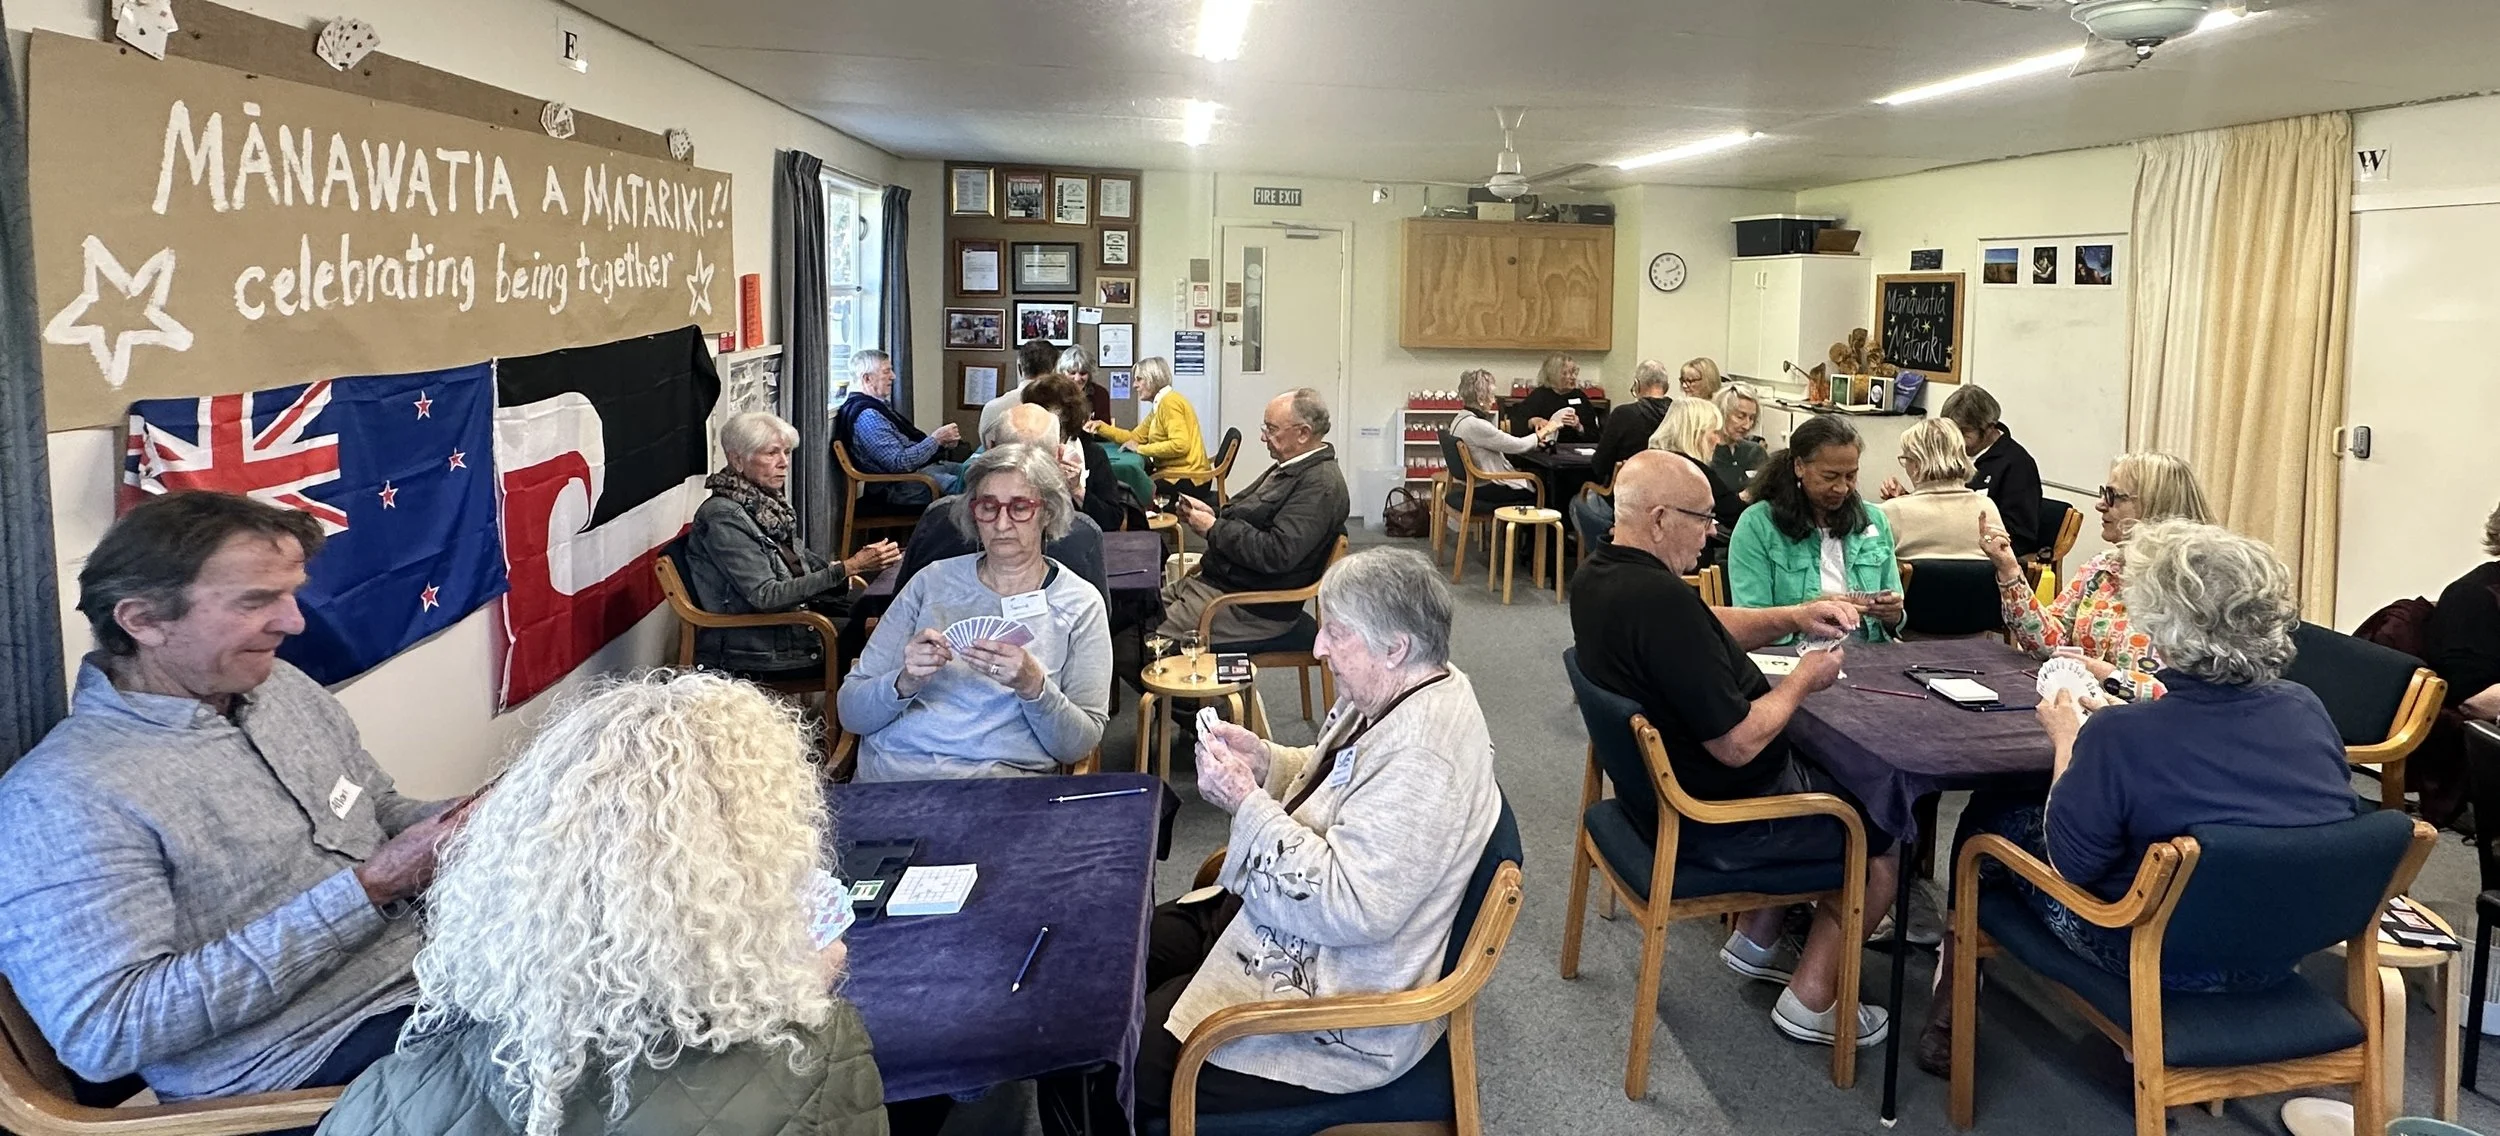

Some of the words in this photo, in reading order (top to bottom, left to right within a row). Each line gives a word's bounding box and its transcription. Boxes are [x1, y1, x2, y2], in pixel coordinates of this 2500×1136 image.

[563, 30, 579, 61] E
[152, 99, 519, 219] MĀNAWATIA
[542, 165, 569, 216] A
[2357, 149, 2387, 172] W
[1256, 188, 1277, 204] FIRE
[1279, 190, 1300, 205] EXIT
[1380, 187, 1389, 200] S
[233, 232, 475, 321] celebrating
[495, 242, 568, 315] being
[576, 241, 674, 304] together
[1911, 317, 1920, 332] a
[1887, 323, 1942, 364] Matariki
